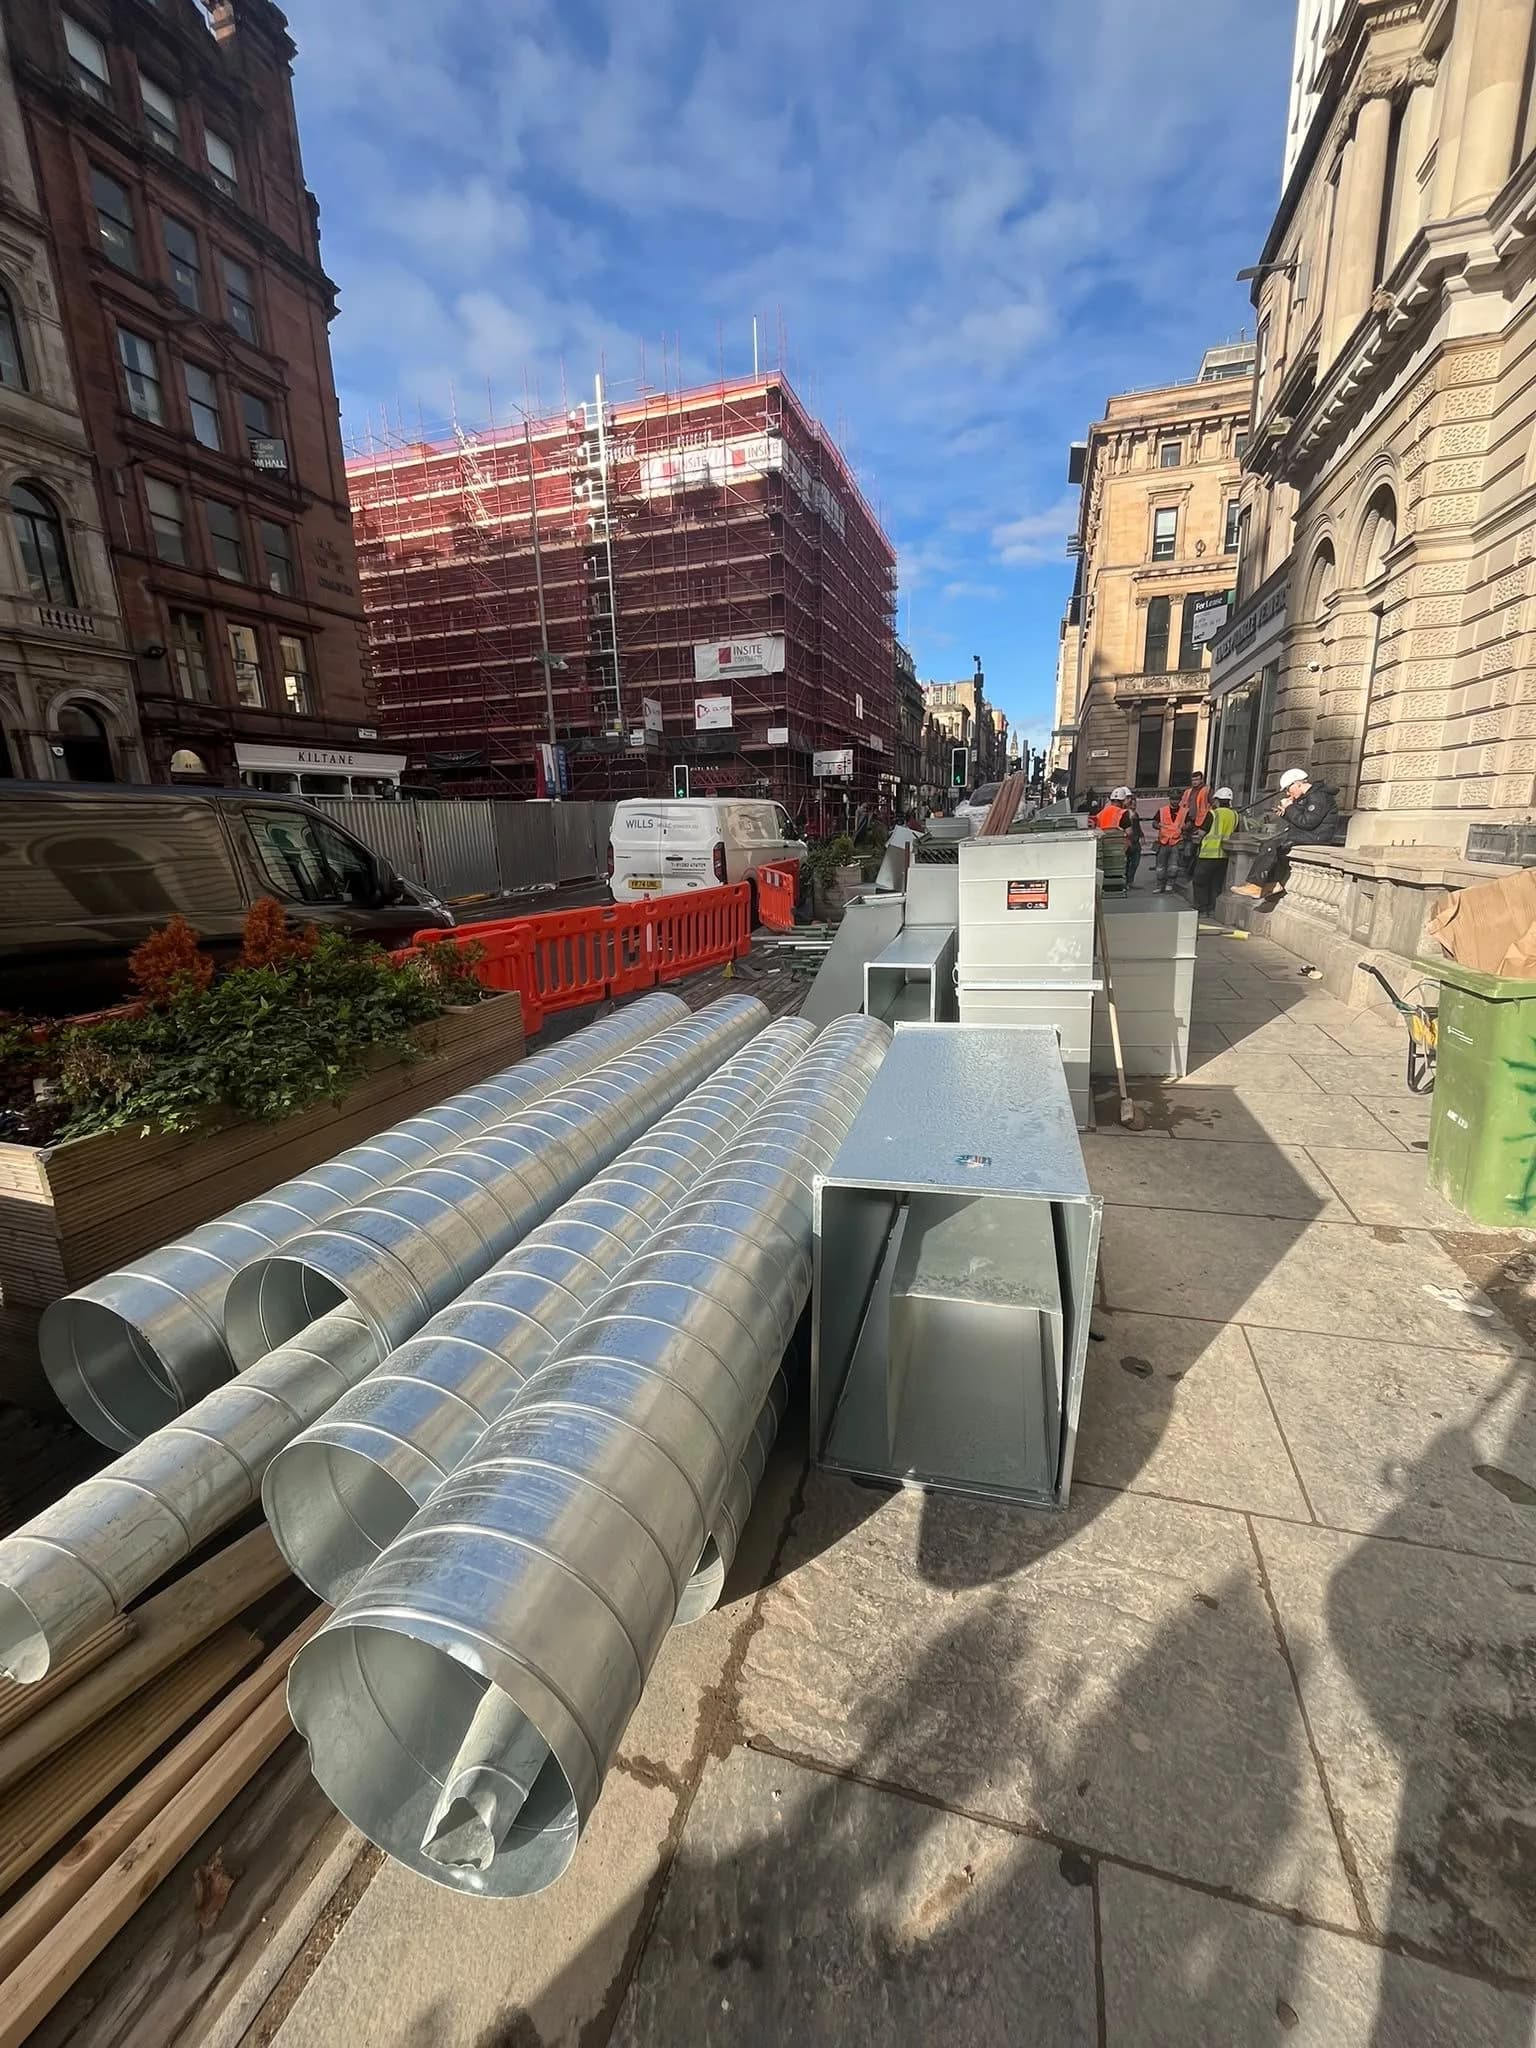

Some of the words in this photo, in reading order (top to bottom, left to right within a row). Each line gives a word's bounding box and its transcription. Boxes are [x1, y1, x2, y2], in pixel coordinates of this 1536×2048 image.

[748, 441, 779, 458] INSITE
[265, 459, 287, 469] HALL
[1195, 602, 1205, 611] For
[734, 644, 762, 656] INSITE
[298, 751, 354, 765] KILTANE
[625, 819, 654, 829] WILLS
